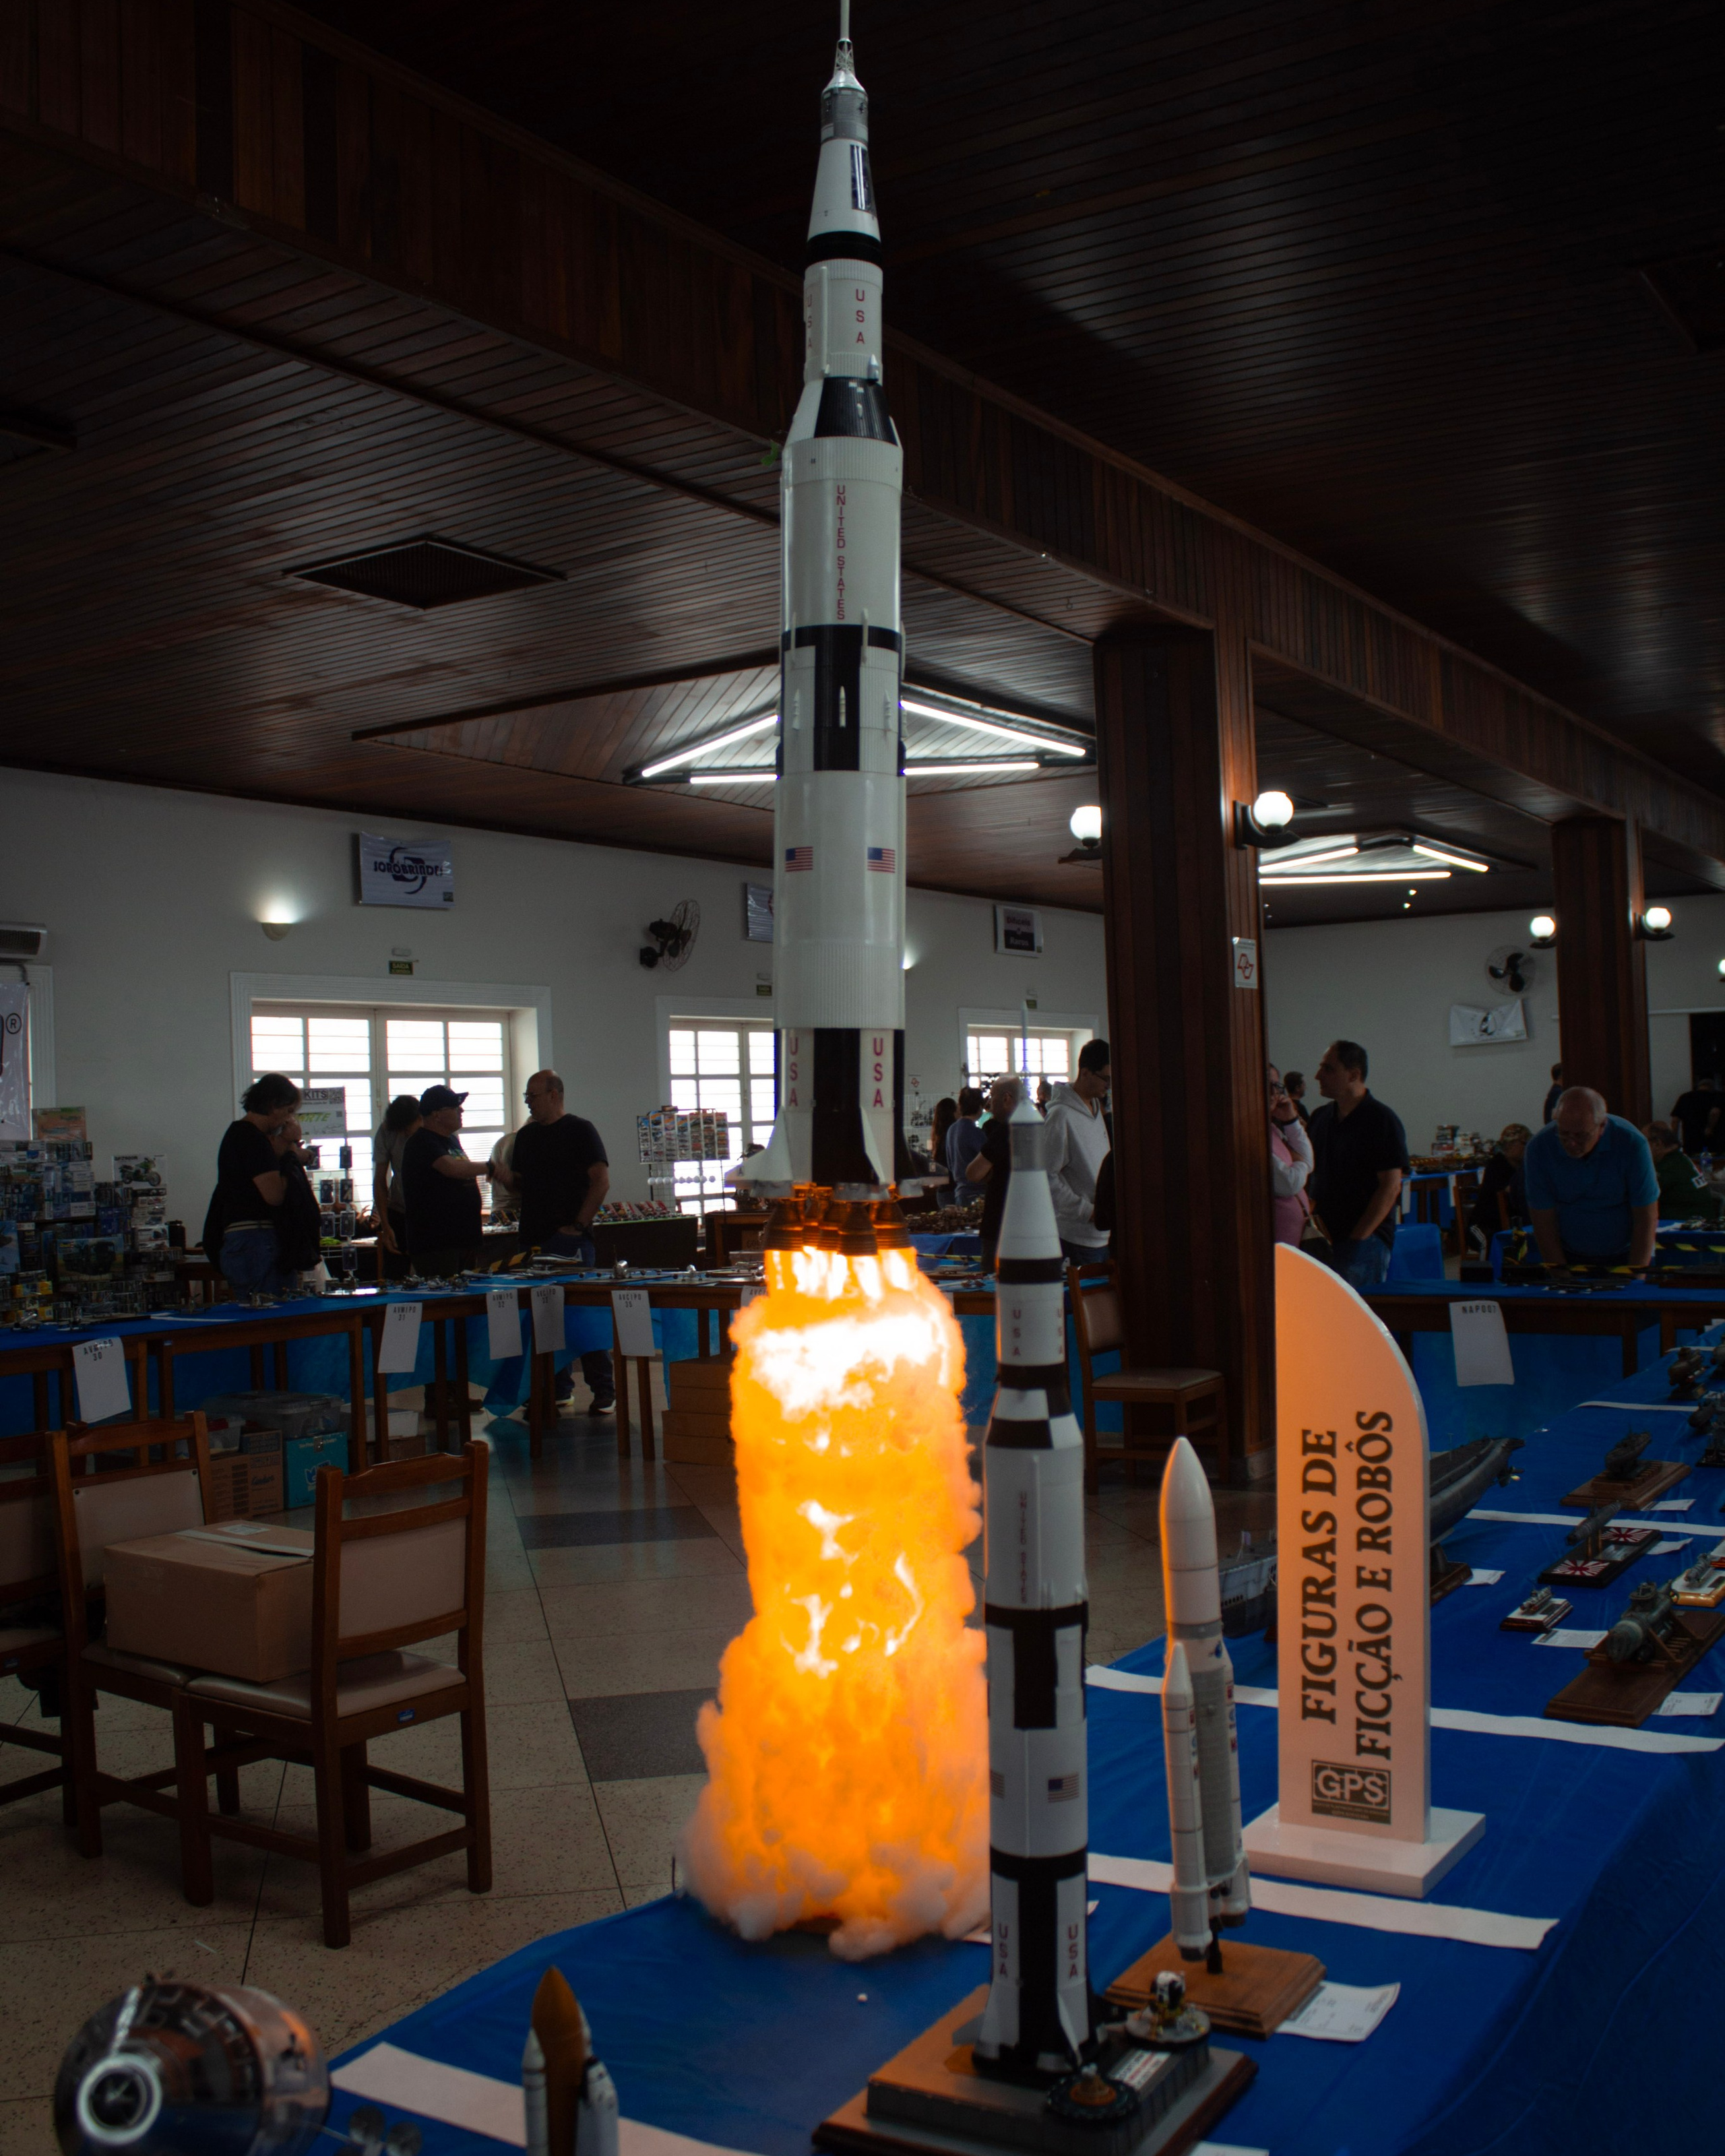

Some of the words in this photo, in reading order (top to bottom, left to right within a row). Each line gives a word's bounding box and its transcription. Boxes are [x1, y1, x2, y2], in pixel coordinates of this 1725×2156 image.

[856, 288, 865, 344] USA
[837, 484, 845, 548] UNITED
[837, 556, 845, 620] STATES
[305, 1090, 327, 1099] KITS
[790, 1037, 798, 1107] USA
[873, 1038, 883, 1107] USA
[93, 1352, 102, 1361] 30
[1013, 1309, 1021, 1356] USA
[1301, 1428, 1338, 1497] DE
[1344, 1410, 1394, 1556] ROBÔS
[1356, 1564, 1393, 1593] E
[1301, 1510, 1338, 1725] FIGURAS
[1348, 1603, 1404, 1761] FICÇÃO
[1317, 1769, 1385, 1805] GPS
[999, 1923, 1008, 1978] USA
[1068, 1924, 1078, 1979] USA
